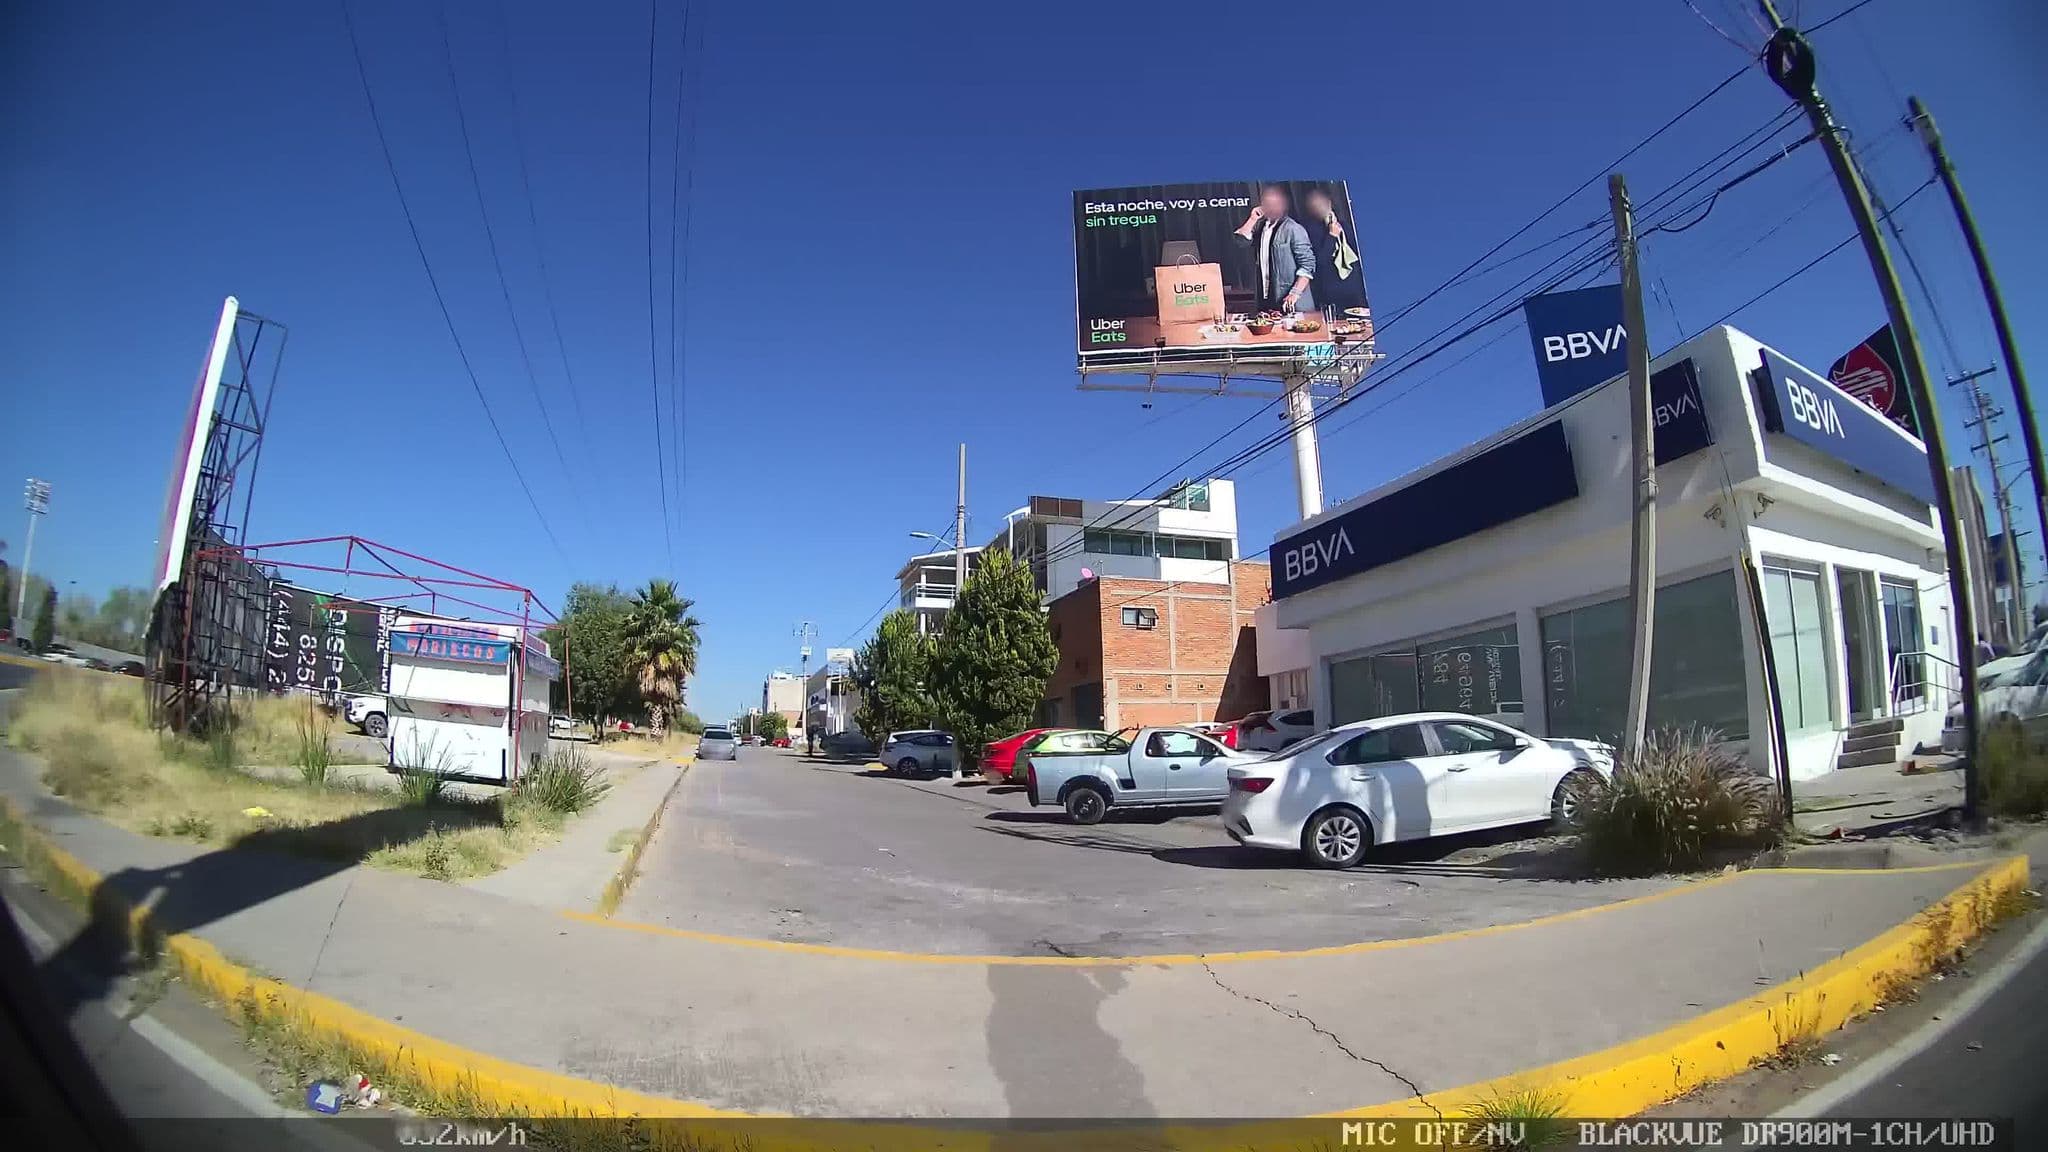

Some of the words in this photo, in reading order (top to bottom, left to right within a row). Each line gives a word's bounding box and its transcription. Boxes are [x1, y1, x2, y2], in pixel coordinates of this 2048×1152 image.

[1085, 201, 1115, 214] Esta
[1118, 198, 1167, 212] noche,
[1169, 199, 1196, 212] voy
[1198, 199, 1207, 208] a
[1209, 196, 1250, 208] cenar
[1085, 215, 1106, 228] sin
[1109, 213, 1157, 227] tregua
[1173, 282, 1207, 294] Uber
[1175, 294, 1209, 306] Eats
[1090, 318, 1125, 330] Uber
[1091, 330, 1126, 344] Eats
[1543, 324, 1629, 362] BBVA
[1653, 393, 1697, 429] BVA
[1785, 376, 1845, 439] BBVA
[1285, 526, 1354, 581] BBVA
